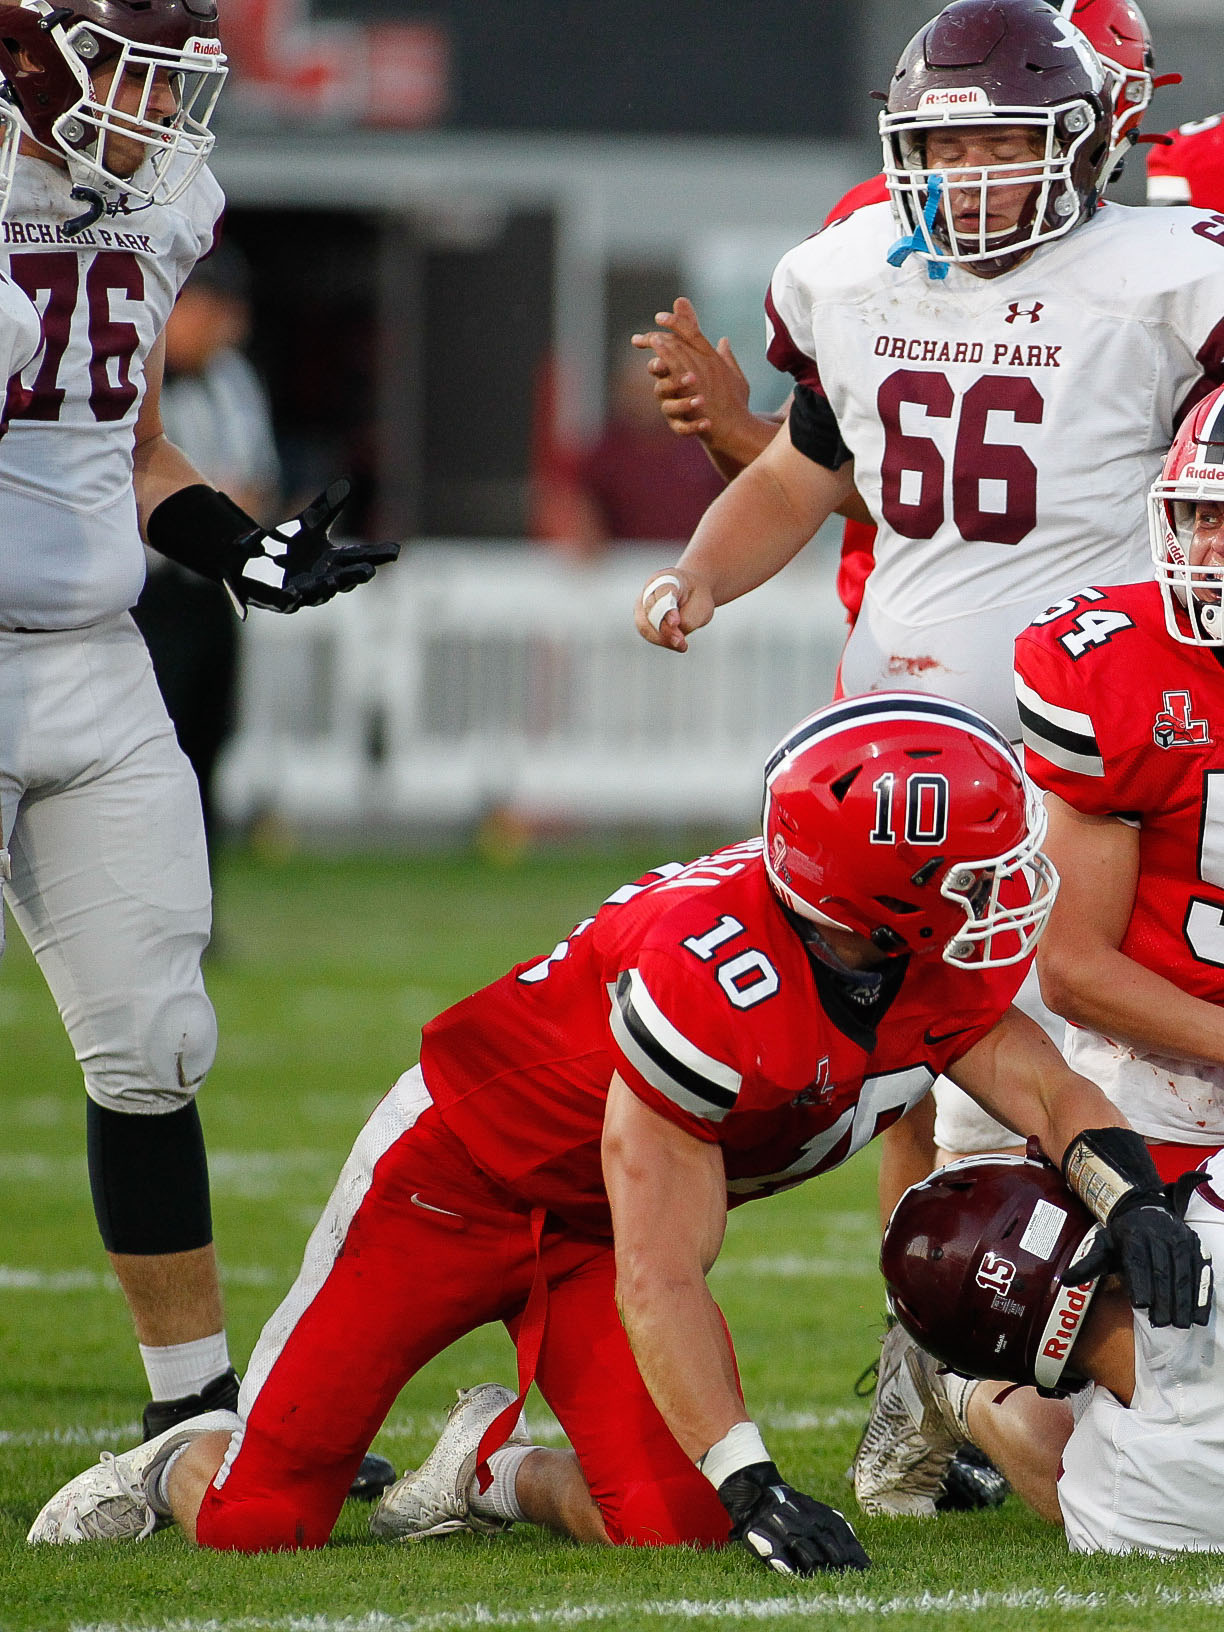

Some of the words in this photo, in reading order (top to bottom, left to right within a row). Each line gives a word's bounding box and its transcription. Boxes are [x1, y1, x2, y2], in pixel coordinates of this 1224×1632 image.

[98, 229, 157, 254] PARK
[8, 252, 145, 423] 76
[874, 335, 983, 363] ORCHARD
[992, 343, 1062, 368] PARK
[877, 368, 1045, 546] 66
[869, 772, 950, 846] 10
[679, 913, 781, 1011] 10
[976, 1253, 1016, 1297] 15
[1043, 1277, 1095, 1361] Ridde
